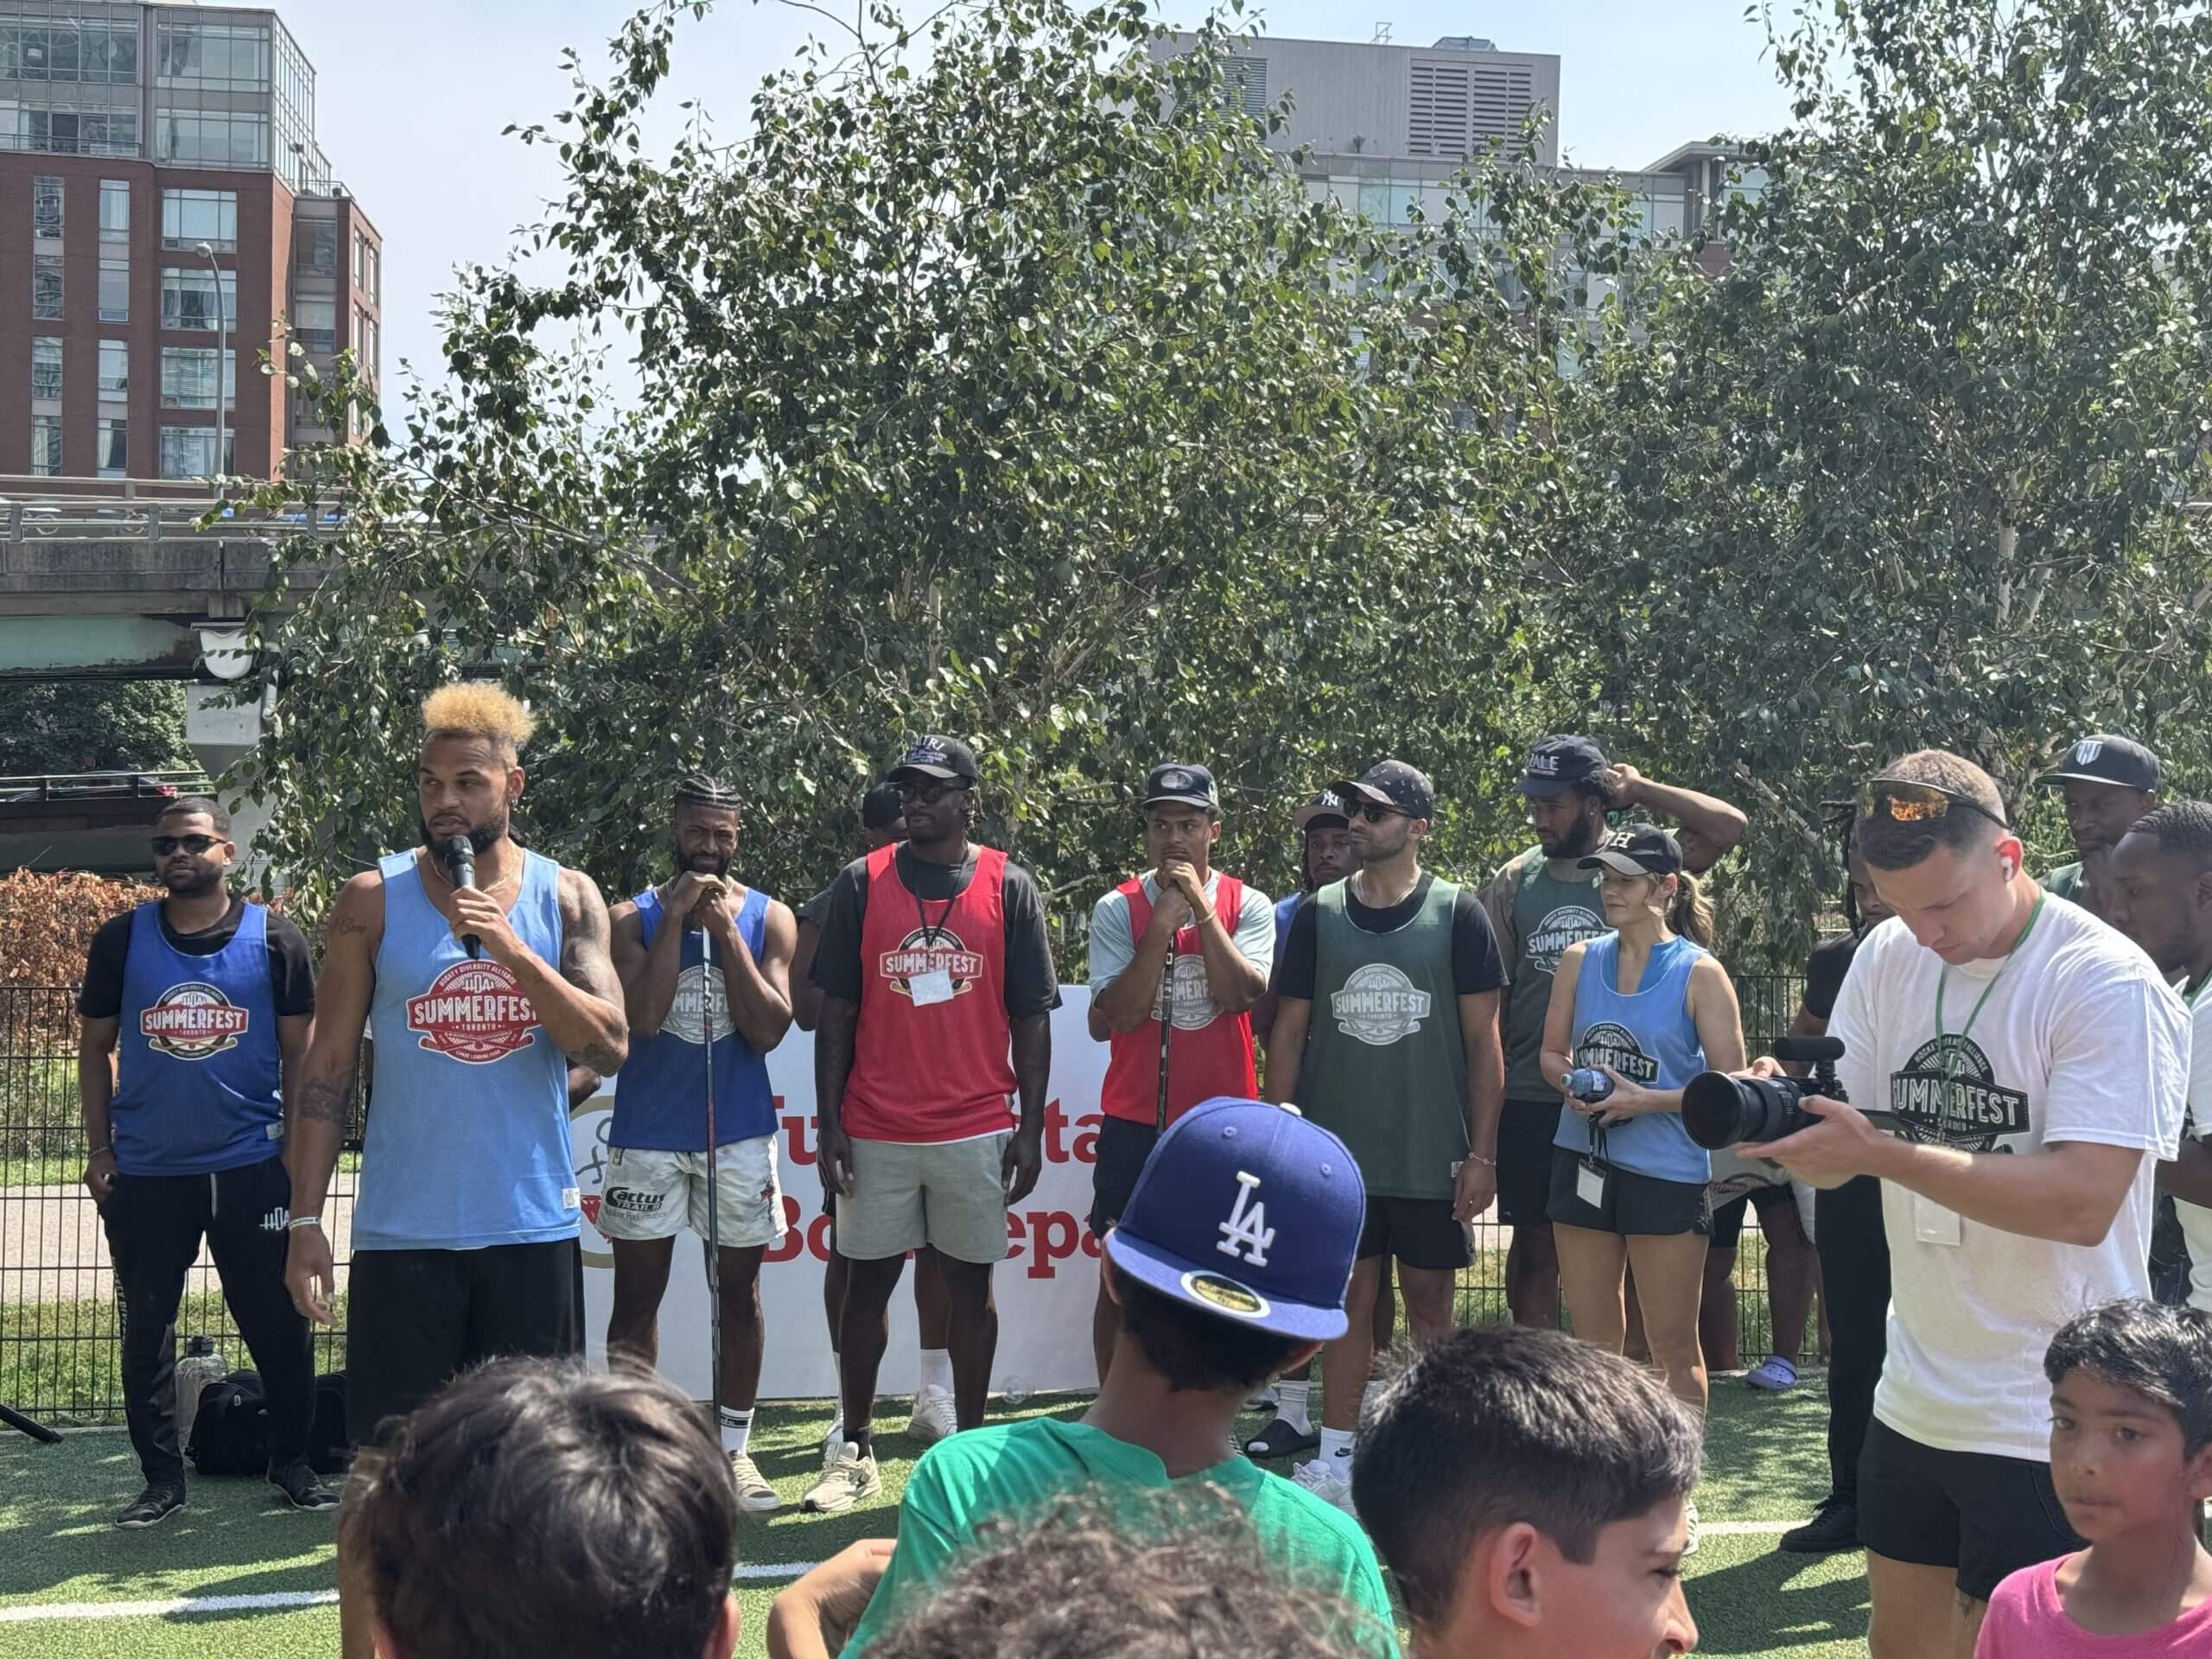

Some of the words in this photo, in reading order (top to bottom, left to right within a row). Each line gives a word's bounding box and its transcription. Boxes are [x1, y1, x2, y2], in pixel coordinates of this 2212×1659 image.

[1335, 991, 1424, 1014] SUMMERFEST
[145, 1008, 243, 1030] SUMMERFEST
[1915, 1042, 1937, 1064] HOCKE
[1217, 1171, 1275, 1267] LA
